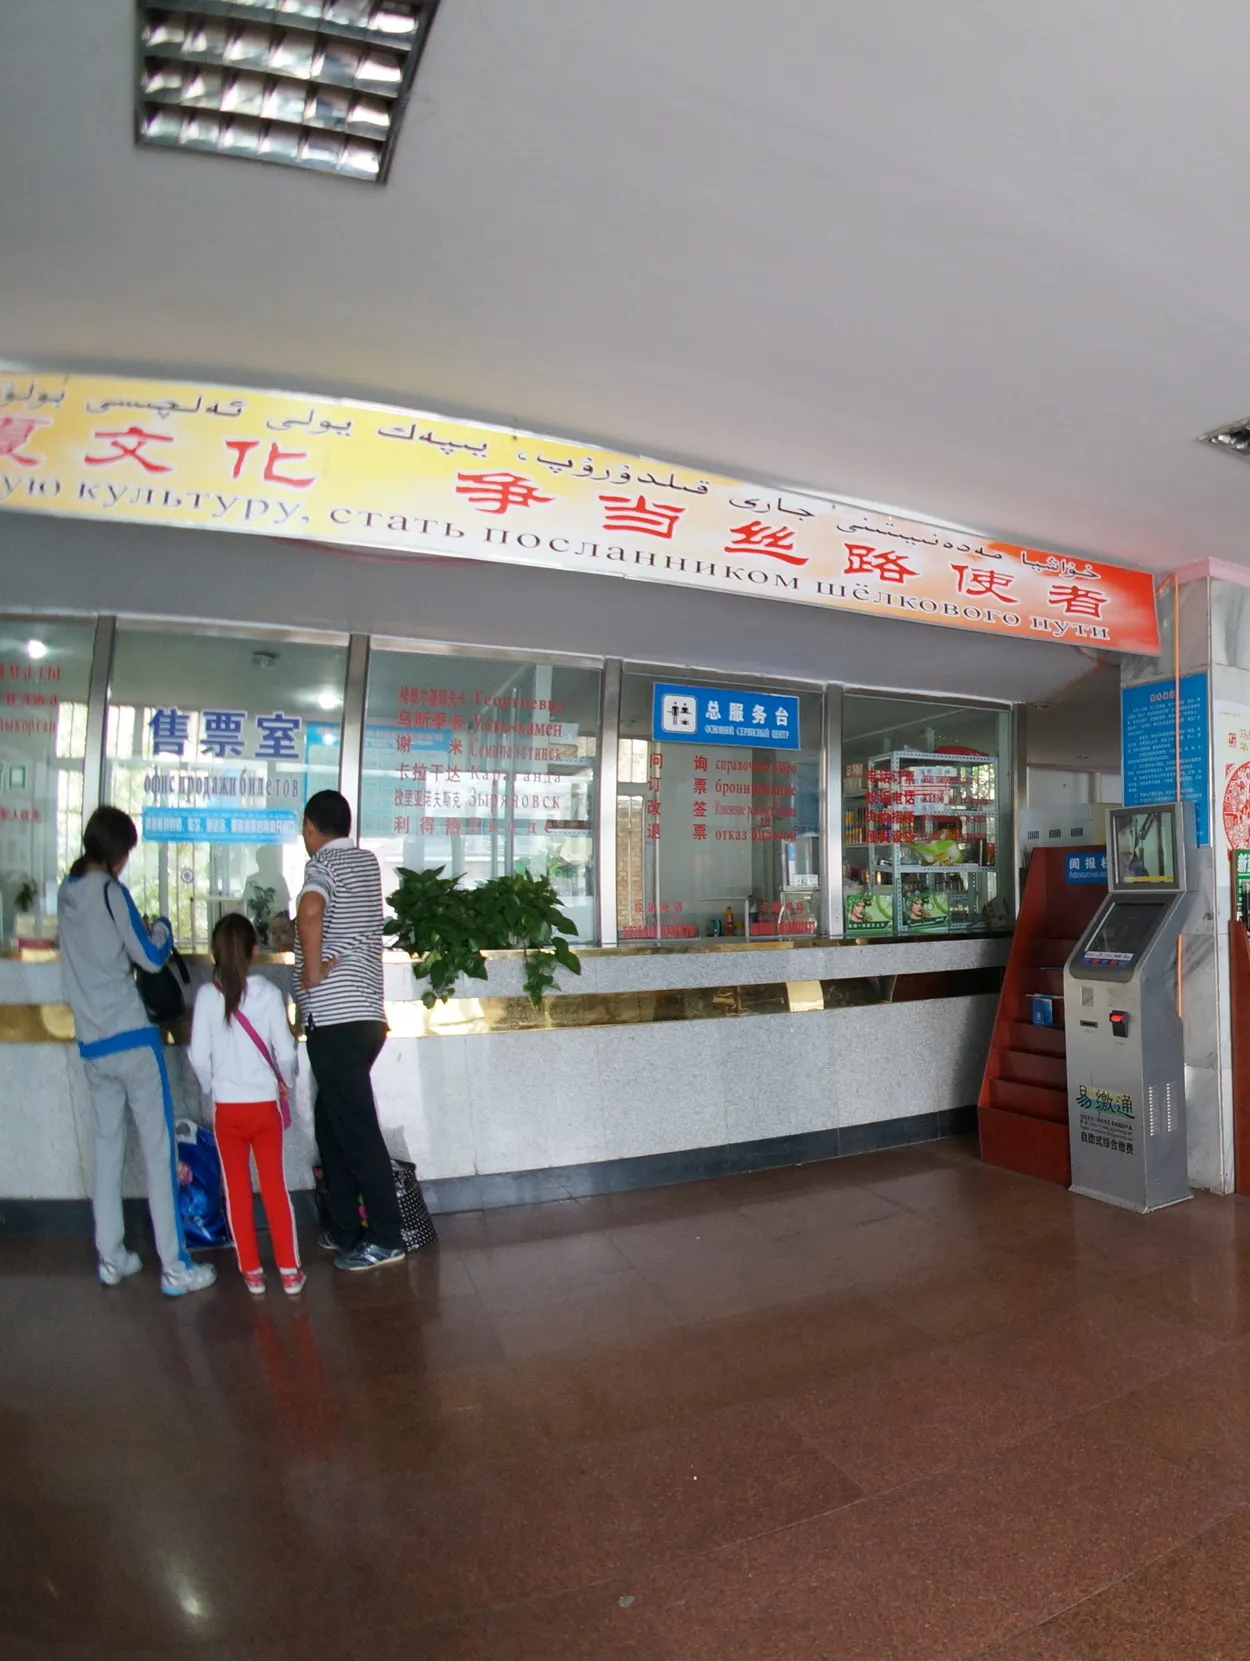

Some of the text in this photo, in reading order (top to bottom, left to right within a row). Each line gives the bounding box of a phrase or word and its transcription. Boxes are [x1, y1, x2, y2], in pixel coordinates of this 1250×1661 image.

[78, 480, 308, 525] культуру,
[330, 507, 464, 538] стать
[486, 527, 799, 590] посланником
[816, 581, 1020, 626] шёлкового
[1030, 615, 1110, 640] пути
[456, 472, 1108, 618] 争当丝路使者
[150, 709, 300, 758] 售票室
[705, 701, 789, 726] 总服务台
[715, 830, 747, 841] отказ
